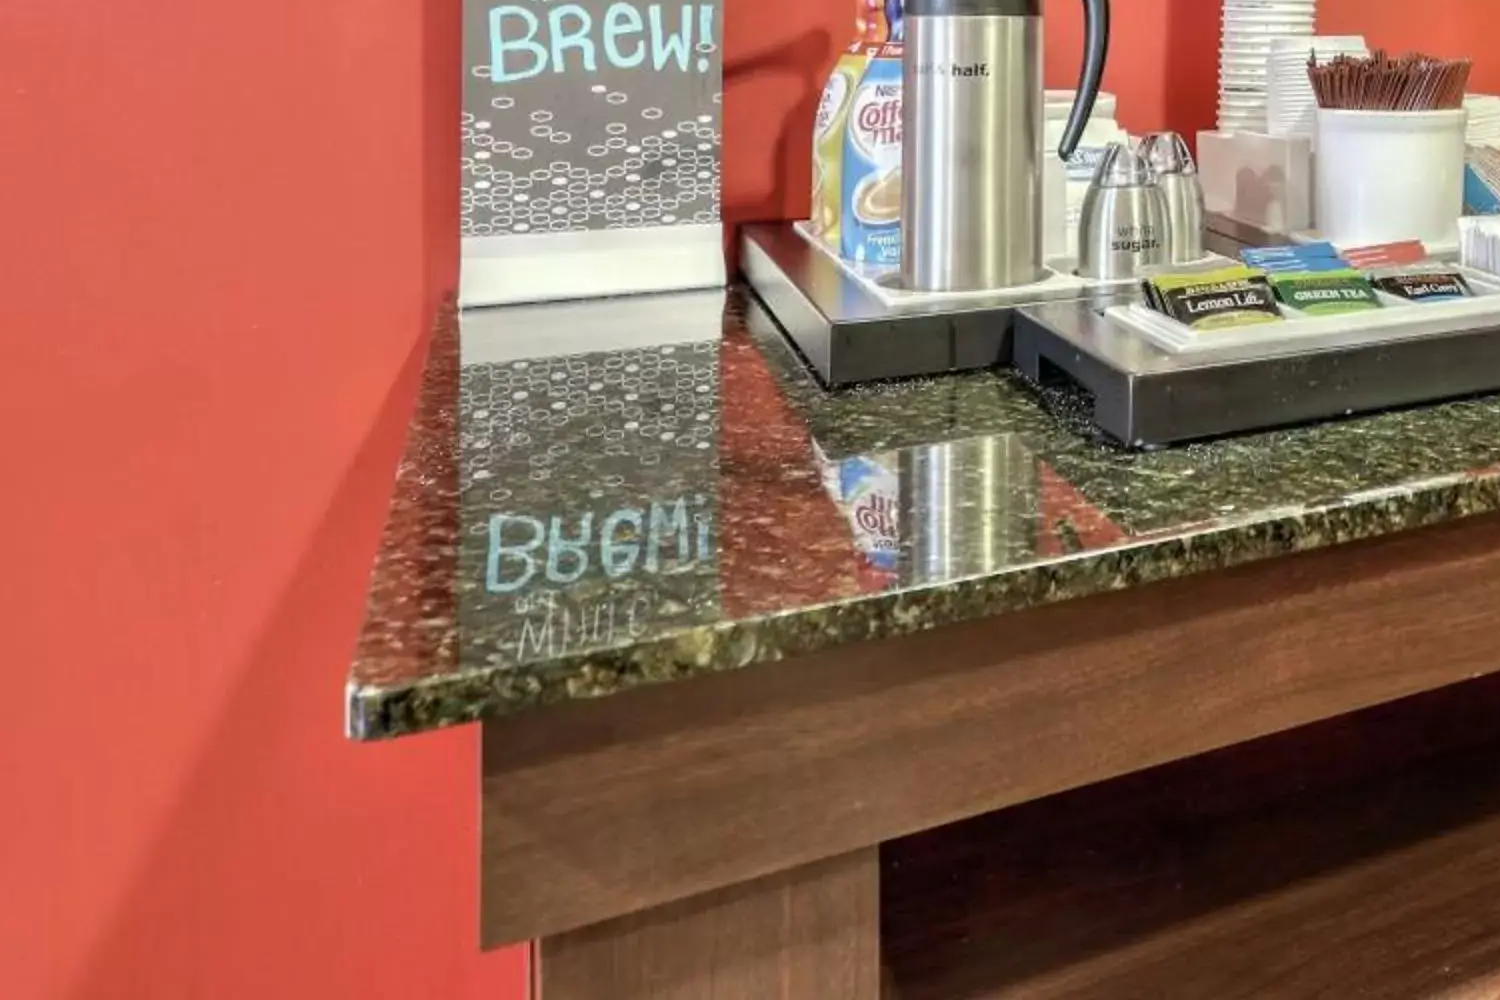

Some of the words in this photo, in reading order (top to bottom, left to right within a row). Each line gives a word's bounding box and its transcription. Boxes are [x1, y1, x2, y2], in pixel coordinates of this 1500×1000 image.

[1111, 238, 1161, 253] sugar.
[1294, 290, 1340, 301] GREEN
[1343, 288, 1370, 299] TEA
[1186, 297, 1234, 313] Lemon
